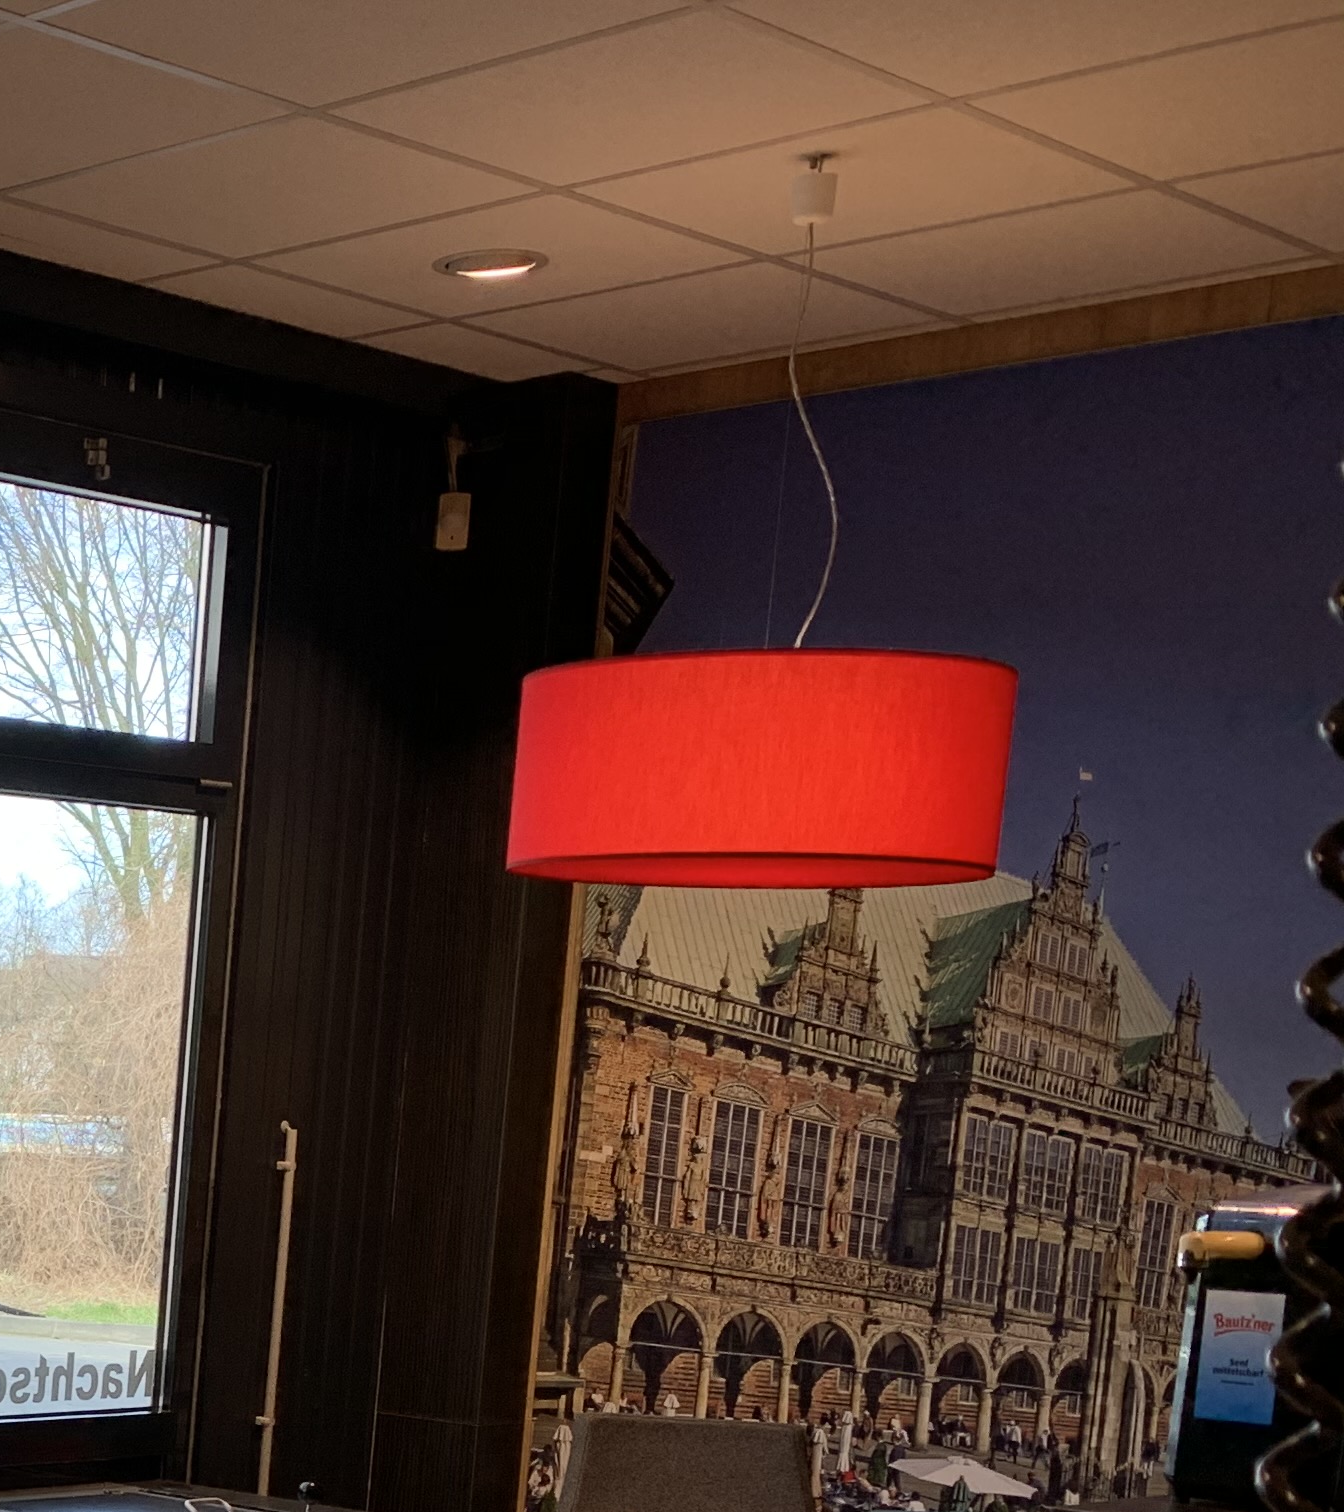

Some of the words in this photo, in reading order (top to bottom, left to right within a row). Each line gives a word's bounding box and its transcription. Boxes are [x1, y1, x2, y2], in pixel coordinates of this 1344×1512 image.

[1214, 1312, 1276, 1333] Bautz'ner
[1229, 1357, 1250, 1368] Senf
[1212, 1366, 1264, 1377] mittelscharf
